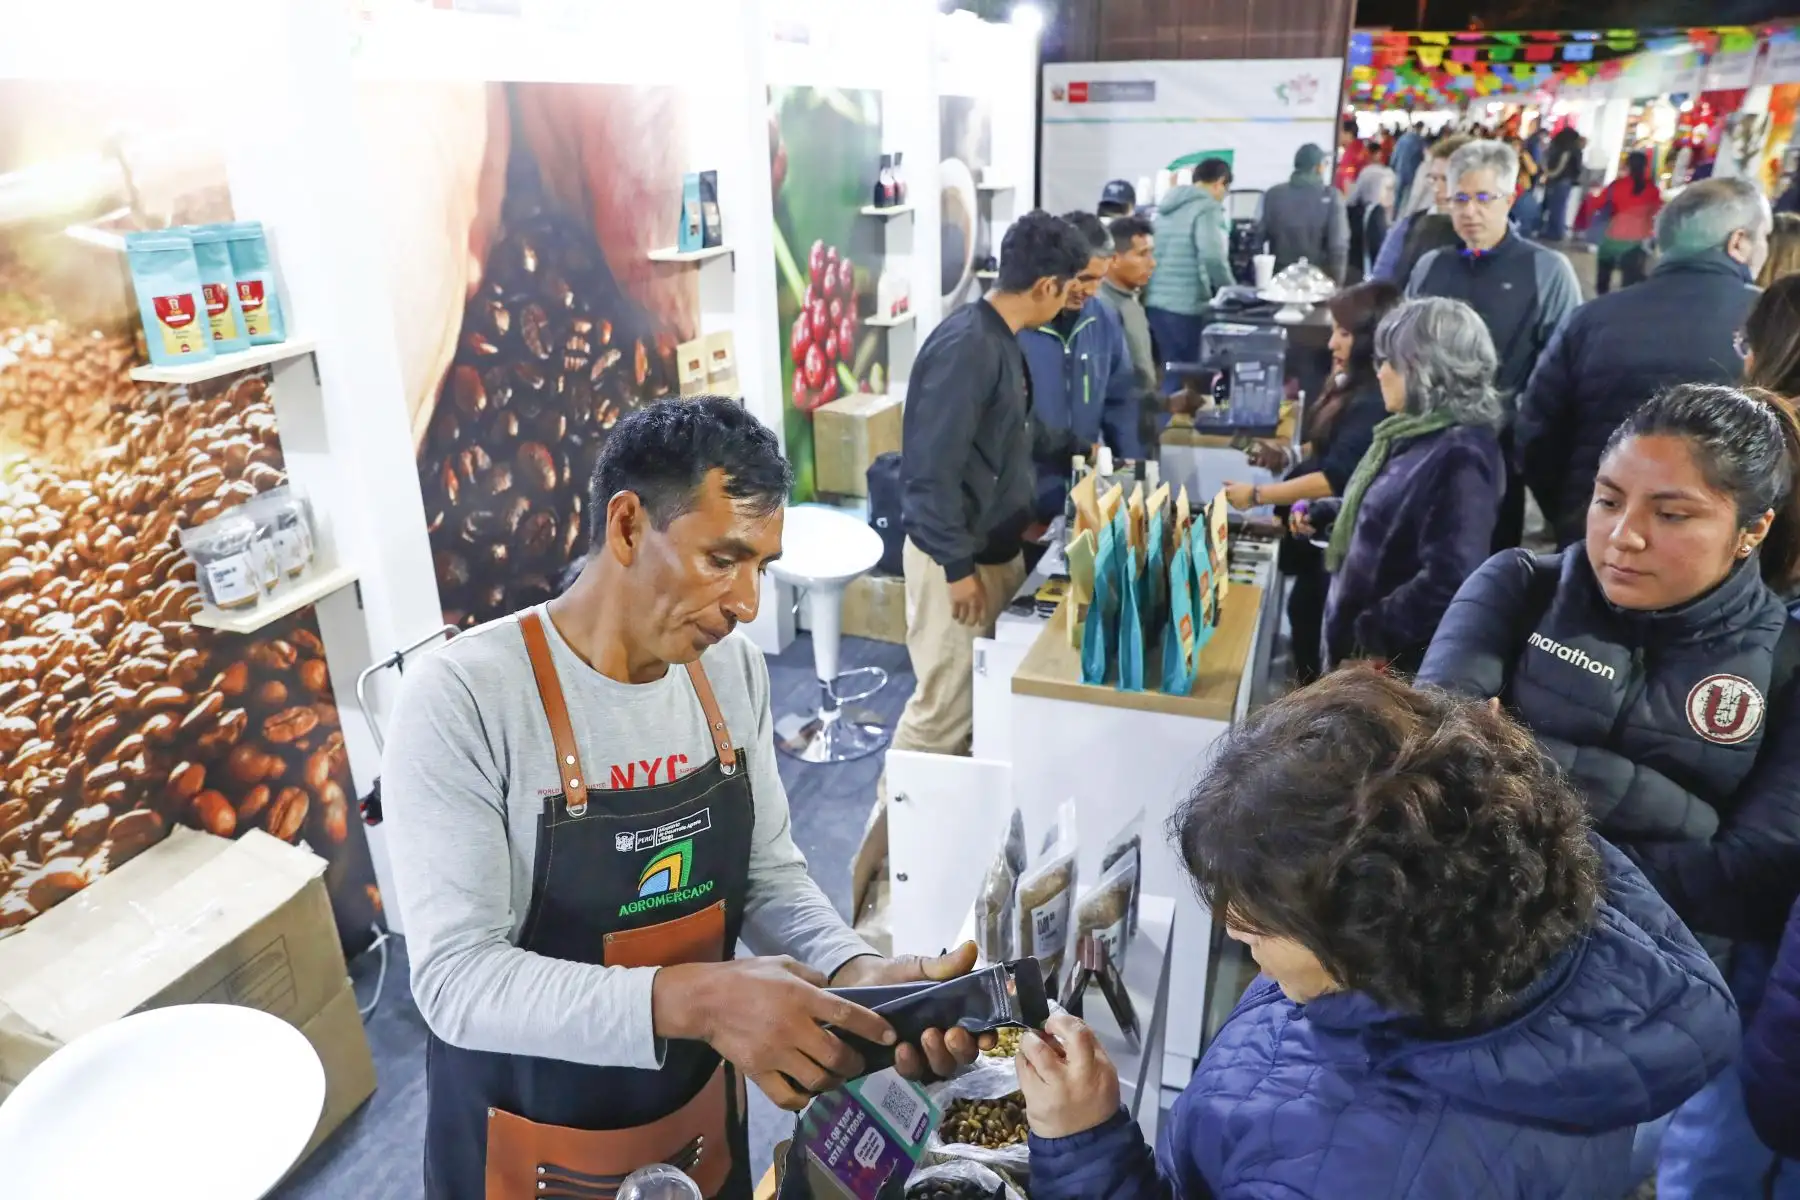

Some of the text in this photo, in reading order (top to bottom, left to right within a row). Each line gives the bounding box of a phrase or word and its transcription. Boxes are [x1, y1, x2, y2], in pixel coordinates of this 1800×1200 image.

[1527, 632, 1616, 681] marathon
[1704, 684, 1751, 734] U
[610, 754, 689, 790] NYC
[618, 880, 714, 917] AGROMERCADO
[824, 1139, 834, 1151] EL
